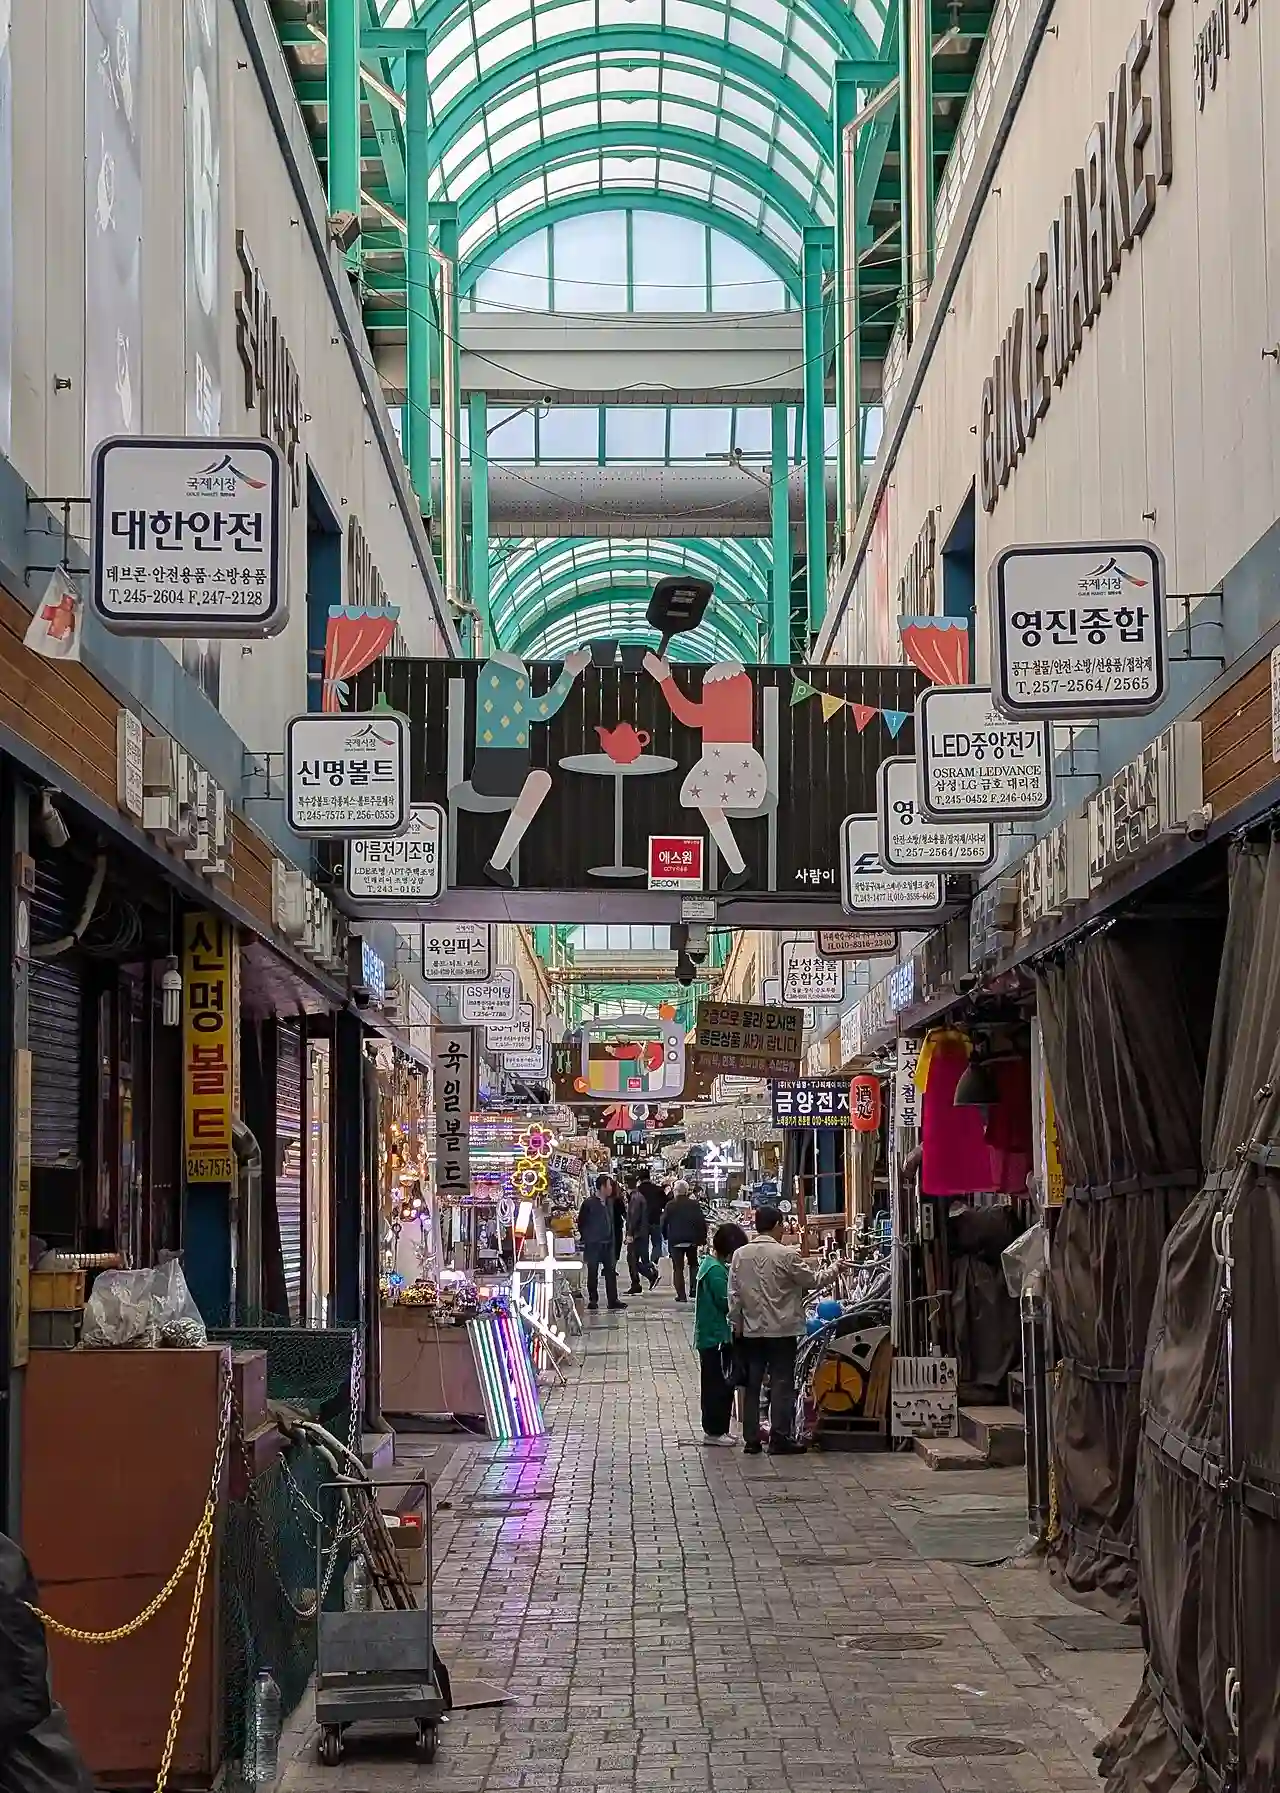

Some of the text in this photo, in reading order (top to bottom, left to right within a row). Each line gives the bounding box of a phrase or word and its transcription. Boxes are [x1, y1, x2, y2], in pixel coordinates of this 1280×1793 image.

[186, 477, 236, 491] 국제시장
[111, 510, 263, 552] 대한안전
[1077, 578, 1122, 590] 국제시장
[109, 589, 263, 606] T.245-2604 F.247-2128
[1011, 607, 1149, 647] 영진종합
[1015, 677, 1149, 696] T.257-2564/2565
[931, 732, 1042, 760] LED중앙전기
[297, 760, 395, 786] 신명볼트
[935, 792, 1043, 806] T.245-0452 F.246-0452
[298, 810, 395, 820] T.245-7575 F.256-0555
[355, 840, 435, 863] 아름전기조명
[658, 850, 692, 865] 에스원
[894, 847, 985, 858] T.257-2564/2565
[650, 880, 679, 888] SECOM
[795, 868, 835, 884] 사람이
[427, 938, 486, 954] 육일피스
[788, 973, 838, 985] 종합상사
[467, 986, 511, 998] GS라이팅
[188, 921, 229, 1151] 신명볼트
[901, 1039, 920, 1127] 보성철물
[437, 1041, 469, 1189] 육일볼트
[188, 1157, 231, 1178] 245-7575
